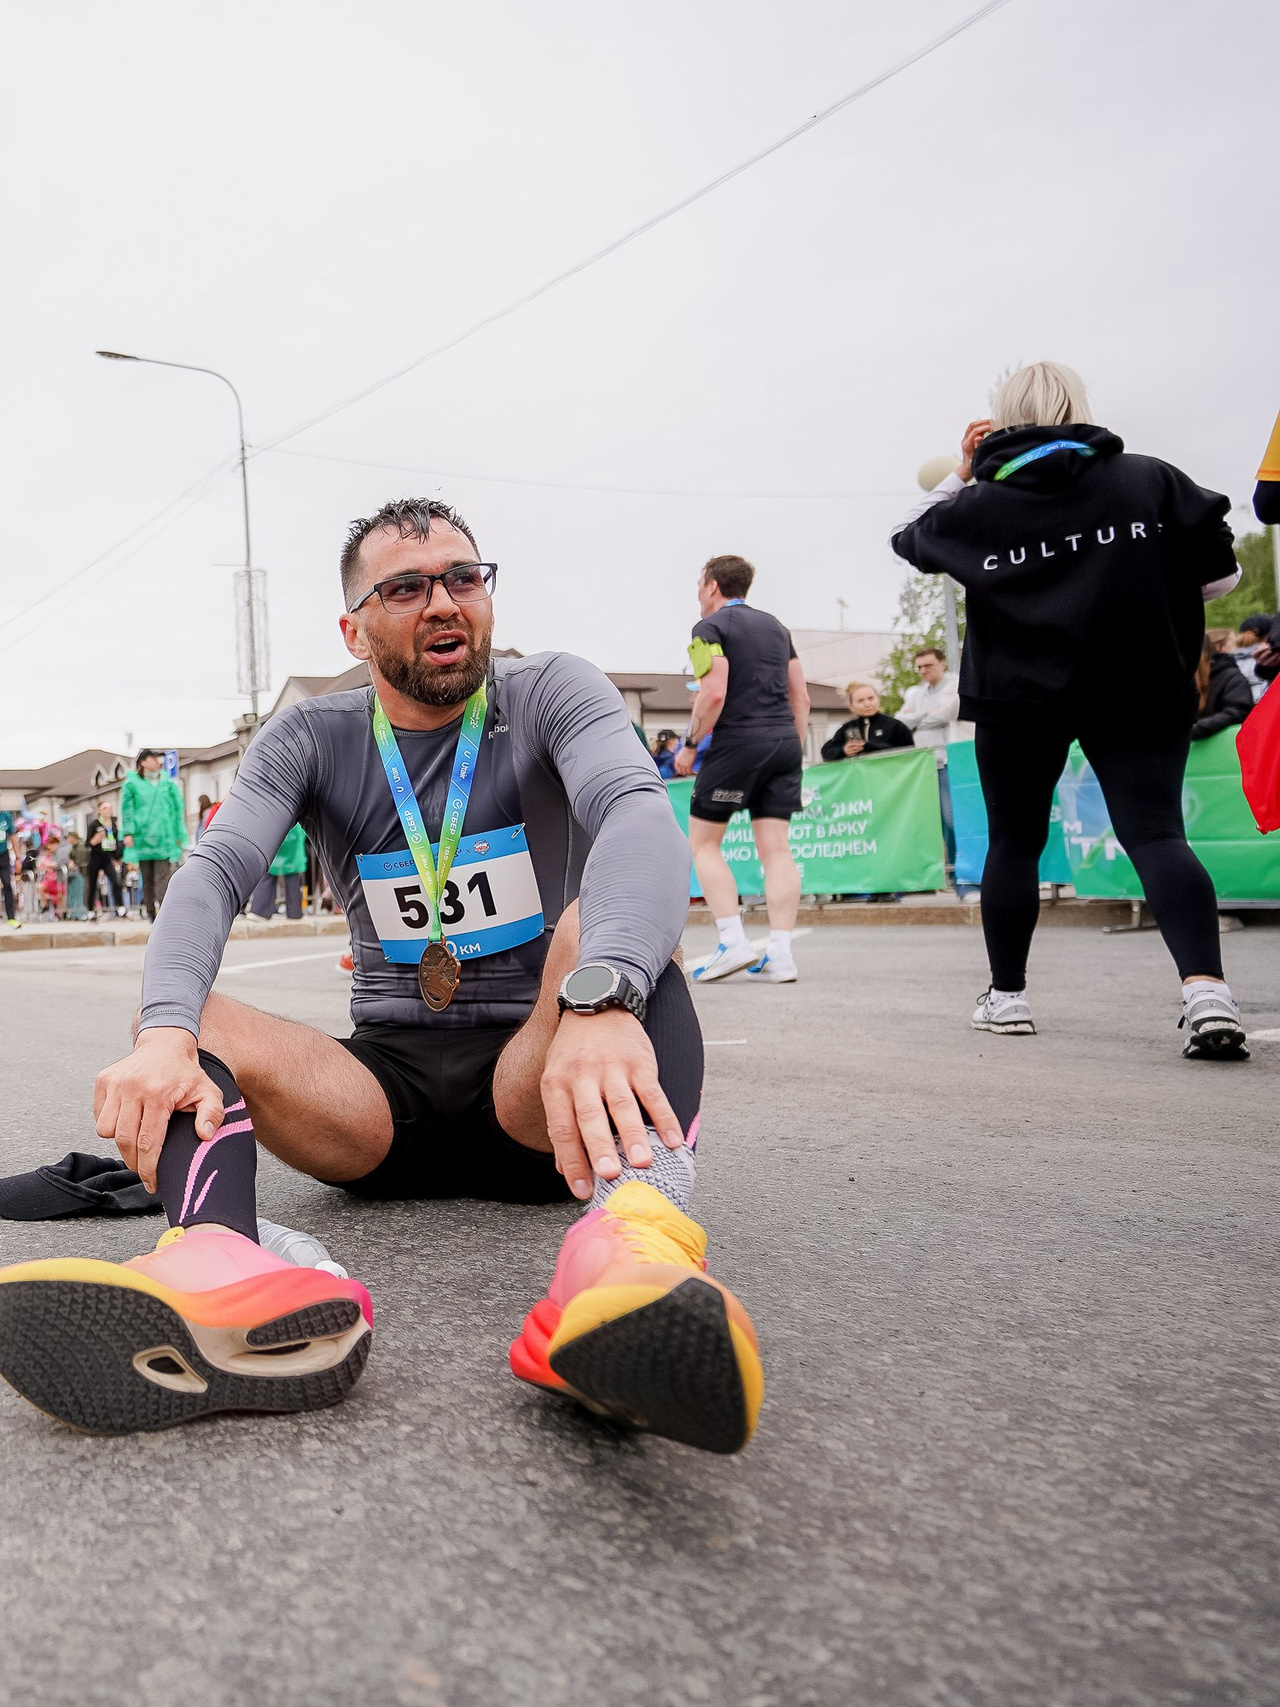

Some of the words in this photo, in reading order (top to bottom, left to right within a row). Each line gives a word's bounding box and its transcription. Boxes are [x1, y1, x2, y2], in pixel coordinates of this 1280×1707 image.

[983, 522, 1163, 570] CULTUR
[404, 810, 418, 832] СБЕР
[449, 811, 460, 836] СБЕР
[828, 820, 868, 838] АРКУ
[790, 839, 878, 860] ОСЛЕДНЕМ
[393, 870, 497, 930] 531
